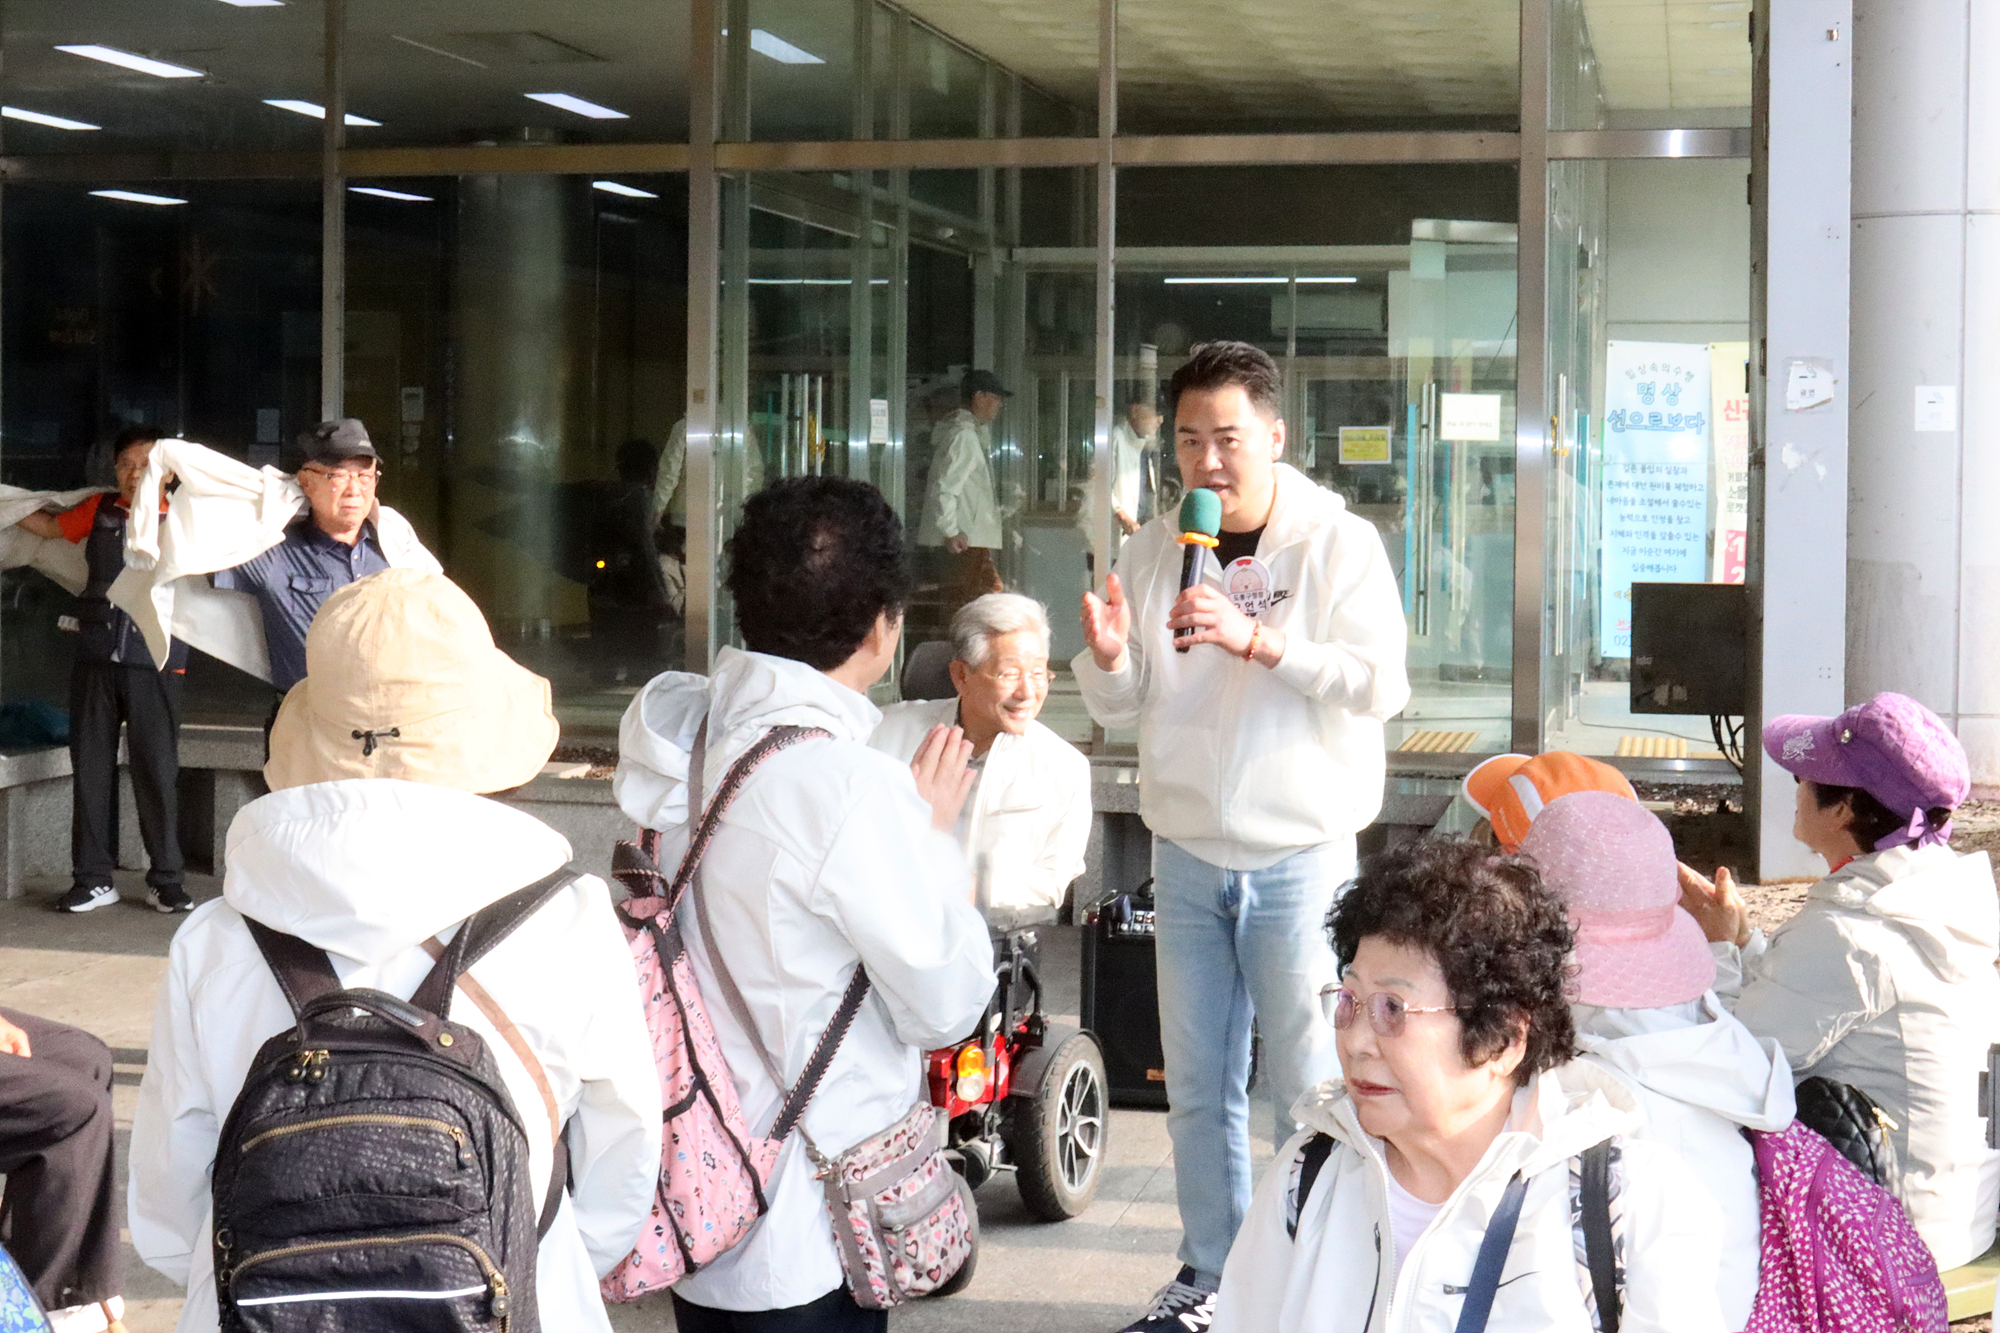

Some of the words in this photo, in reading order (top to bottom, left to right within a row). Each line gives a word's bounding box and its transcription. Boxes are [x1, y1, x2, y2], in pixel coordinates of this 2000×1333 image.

[1607, 408, 1705, 435] 선으로보다
[1632, 481, 1647, 490] 대한
[1676, 515, 1691, 524] 찾고
